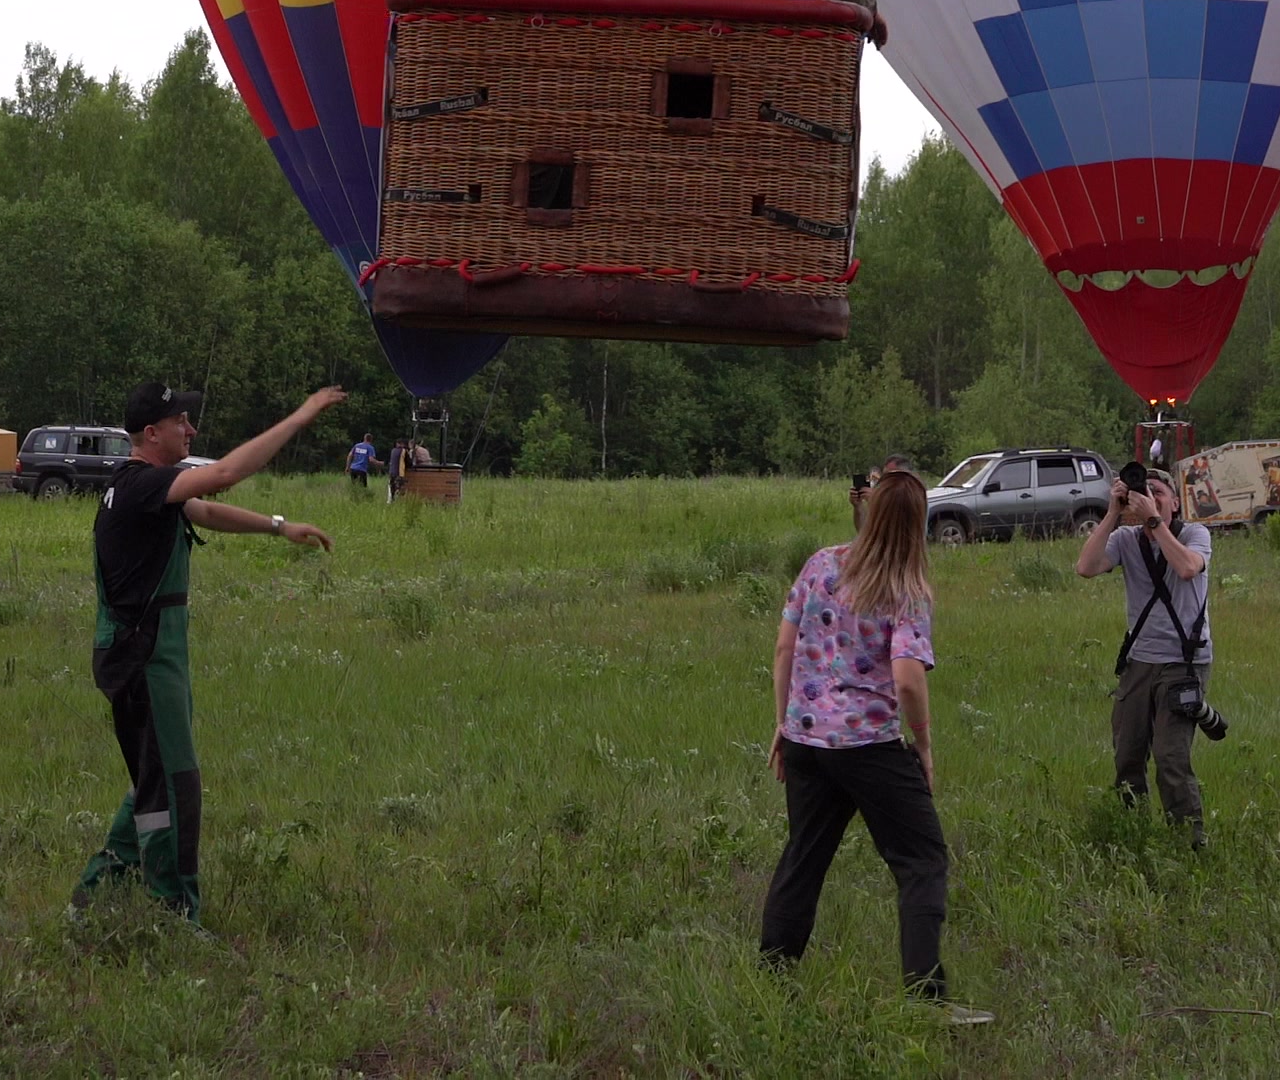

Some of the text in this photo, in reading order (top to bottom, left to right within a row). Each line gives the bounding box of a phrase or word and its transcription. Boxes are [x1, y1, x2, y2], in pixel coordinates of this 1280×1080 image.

[440, 96, 475, 111] Rusbal
[775, 111, 814, 132] Русбал
[403, 190, 441, 202] Русбал
